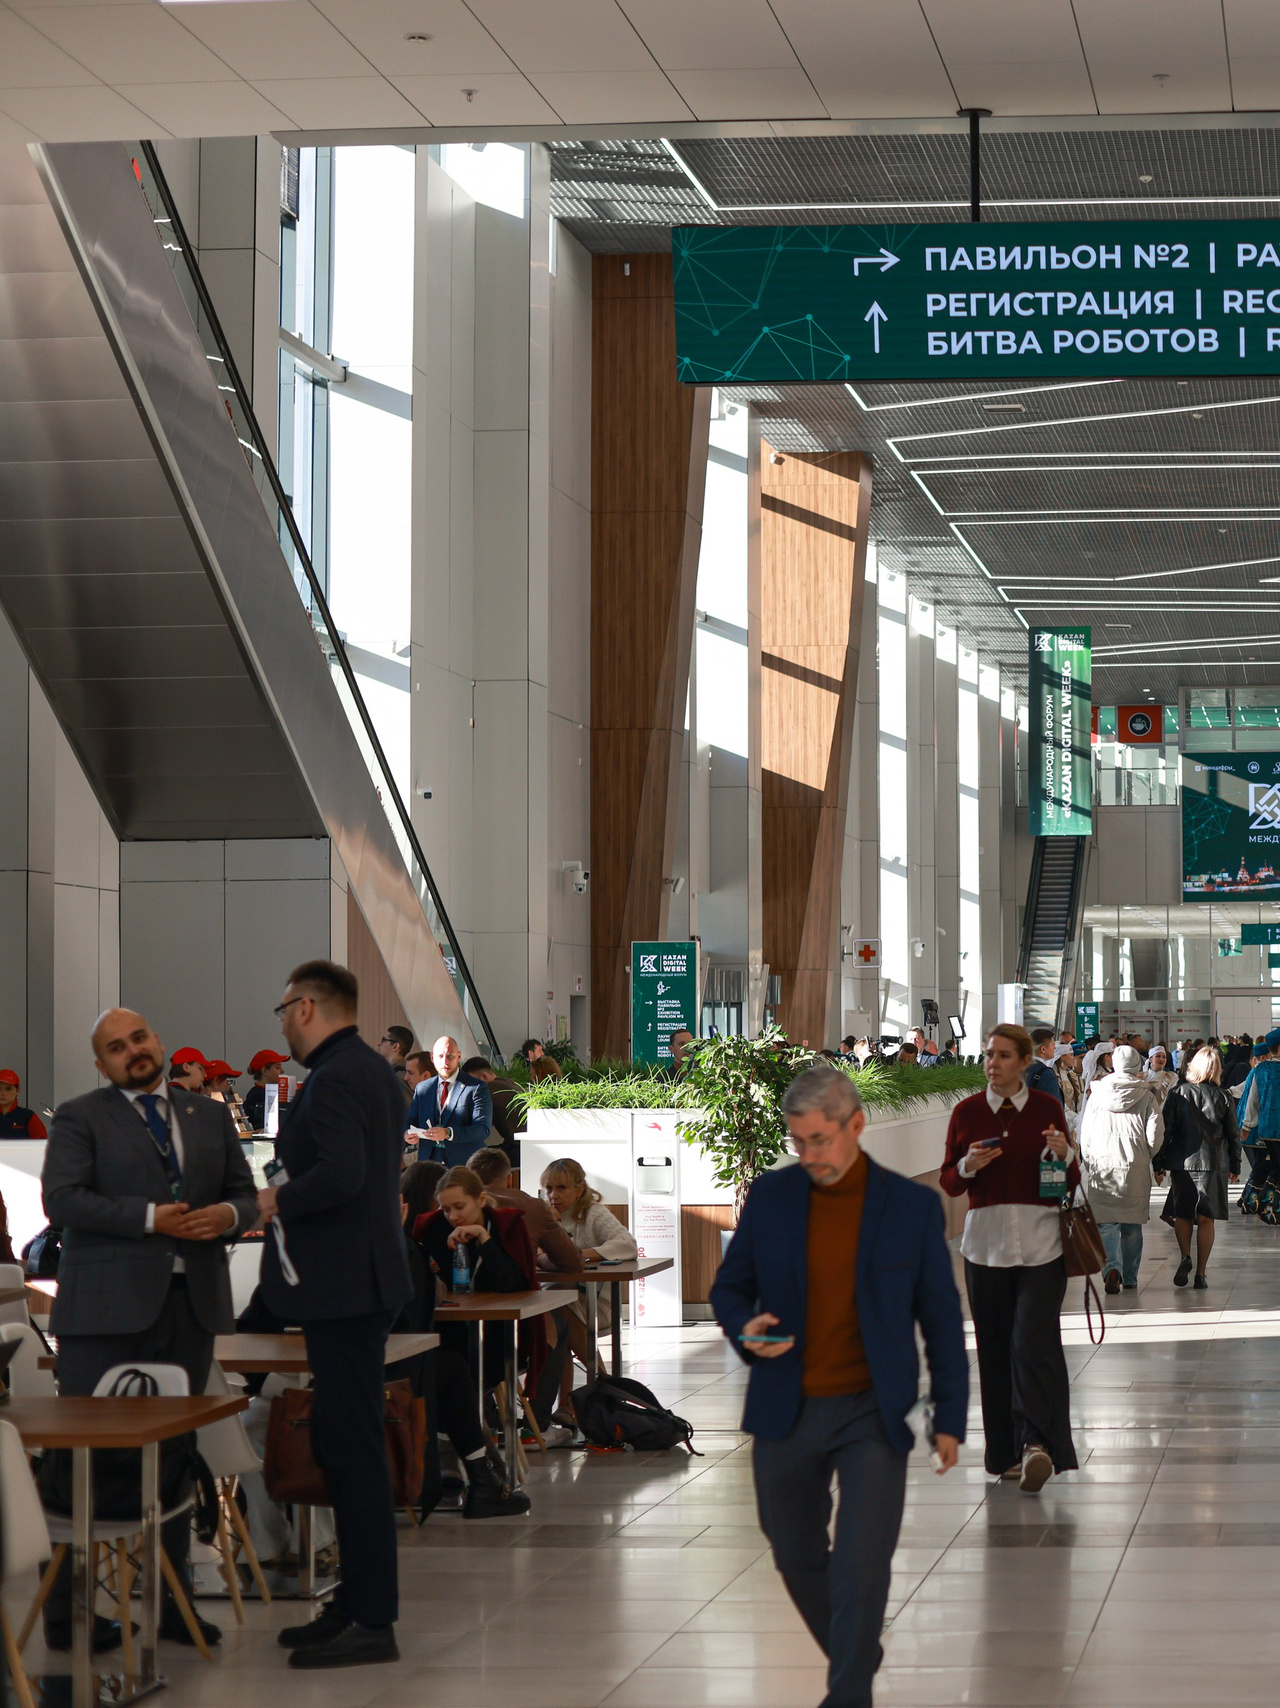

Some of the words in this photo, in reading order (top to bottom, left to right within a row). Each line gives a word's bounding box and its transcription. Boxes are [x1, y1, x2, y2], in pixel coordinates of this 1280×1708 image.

[925, 244, 1121, 271] ПАВИЛЬОН
[1134, 243, 1189, 269] №2
[926, 290, 1174, 319] РЕГИСТРАЦИЯ
[927, 330, 1043, 355] БИТВА
[1053, 328, 1219, 354] РОБОТОВ
[1046, 694, 1054, 728] ФОРУМ
[1062, 710, 1072, 762] DIGITAL
[1046, 730, 1054, 818] МЕЖДУНАРОДНЫЙ
